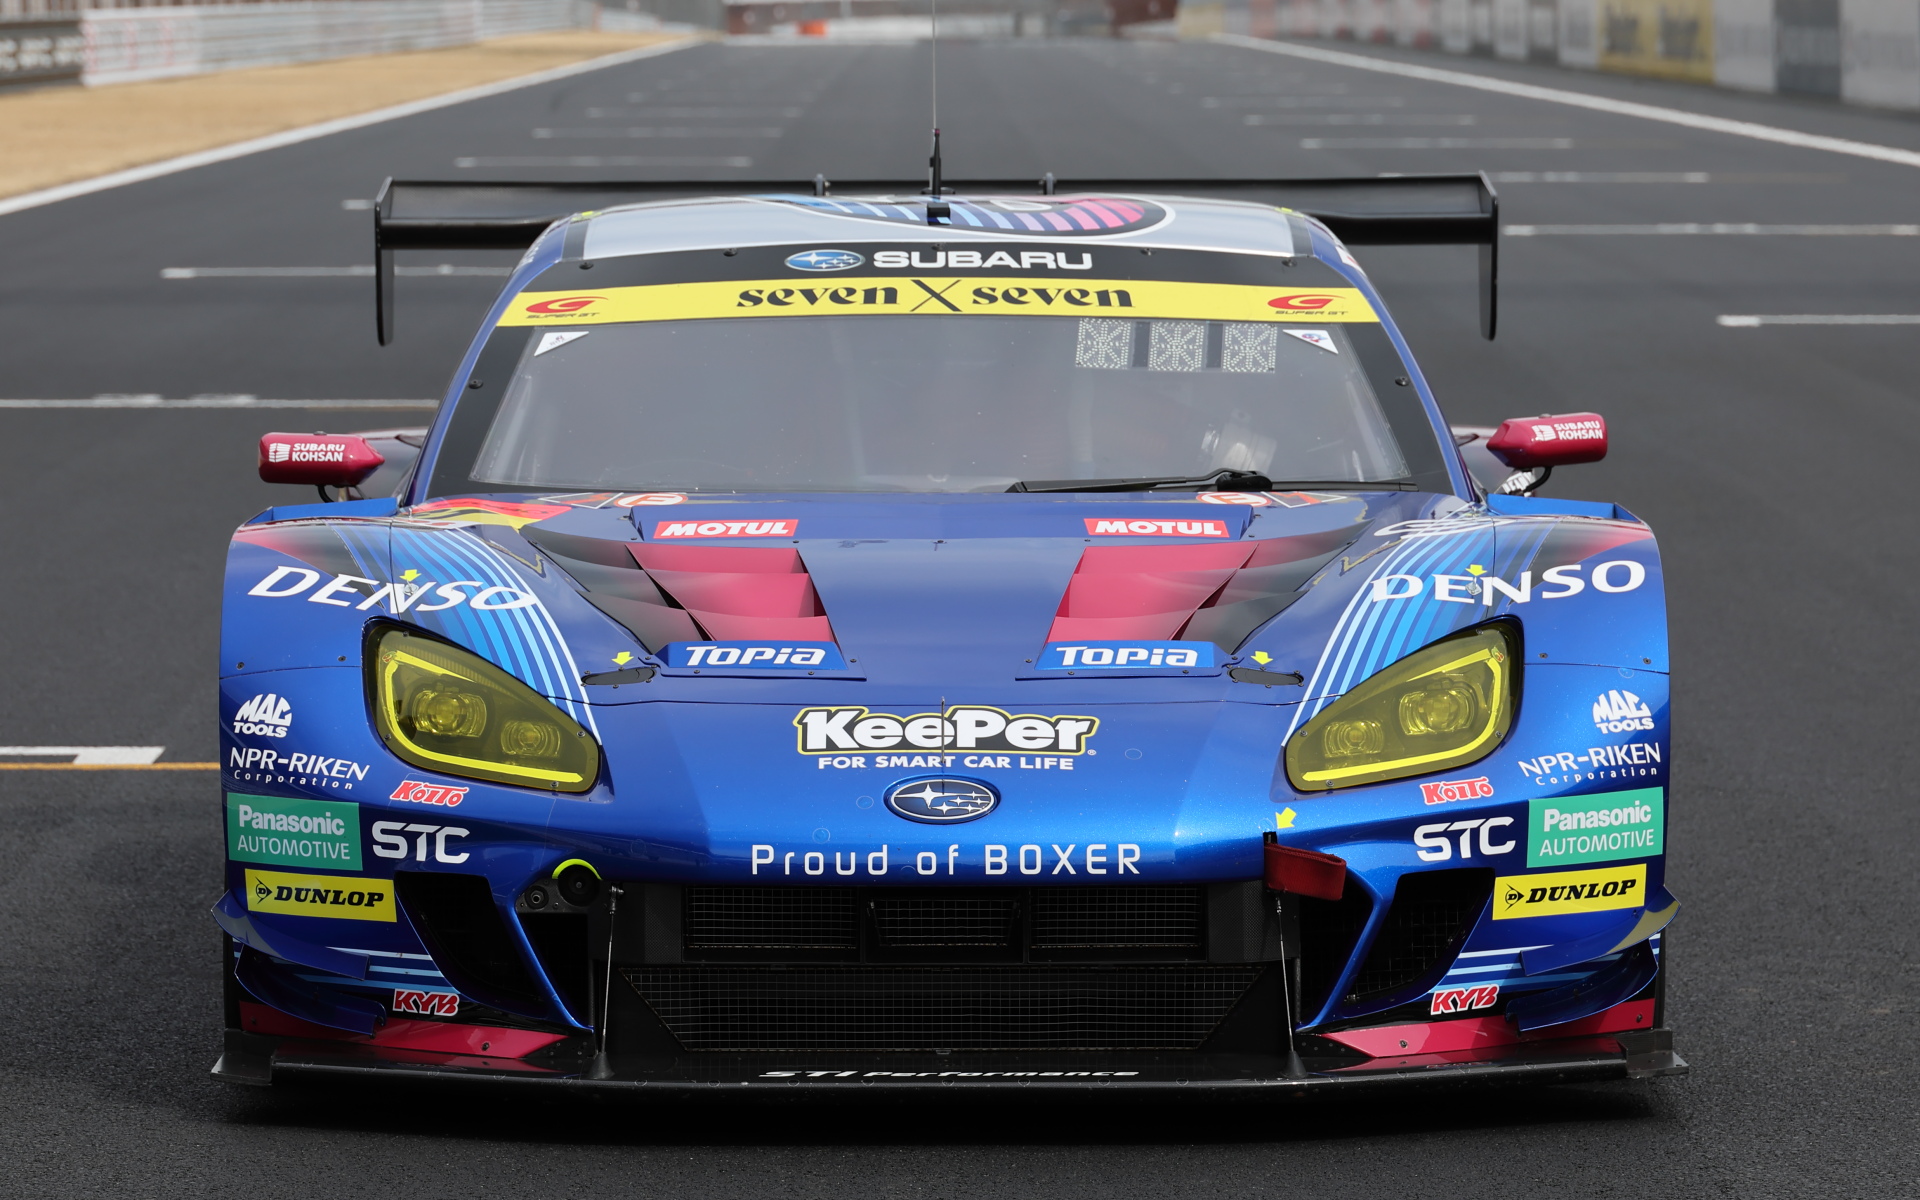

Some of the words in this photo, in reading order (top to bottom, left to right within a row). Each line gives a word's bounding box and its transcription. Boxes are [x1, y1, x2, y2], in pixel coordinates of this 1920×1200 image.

[873, 250, 1093, 270] SUBARU
[736, 286, 899, 308] seven
[971, 286, 1136, 308] seven
[1554, 420, 1601, 431] SUBARU
[1557, 428, 1603, 441] KOHSAN
[291, 451, 344, 463] KOHSAN
[292, 443, 346, 452] SUBARU
[660, 521, 795, 537] MOTUL
[1094, 520, 1223, 536] MOTUL
[247, 565, 540, 616] DENSO
[1369, 559, 1647, 607] DENSO
[234, 693, 293, 726] MAC
[1592, 689, 1652, 723] MAC
[233, 721, 289, 738] TOOLS
[802, 707, 1092, 752] KeePer
[1595, 716, 1655, 734] TOOLS
[230, 746, 371, 782] NPR-RIKEN
[818, 756, 867, 769] FOR
[874, 755, 956, 768] SMART
[963, 756, 1012, 768] CAR
[1019, 757, 1074, 770] LIFE
[1517, 742, 1662, 778] NPR-RIKEN
[233, 769, 354, 791] Corporation
[1535, 766, 1658, 786] Corporation
[238, 804, 345, 836] Panasonic
[1543, 800, 1652, 832] Panasonic
[237, 834, 350, 860] AUTOMOTIVE
[371, 820, 471, 865] STC
[1413, 816, 1517, 862] STC
[1539, 828, 1655, 857] AUTOMOTIVE
[750, 844, 888, 876] Proud
[916, 844, 960, 876] of
[984, 843, 1142, 876] BOXER
[273, 885, 384, 908] DUNLOP
[1525, 878, 1637, 904] DUNLOP
[392, 988, 460, 1017] KYB
[1431, 984, 1500, 1016] KYB
[758, 1070, 858, 1078] STI
